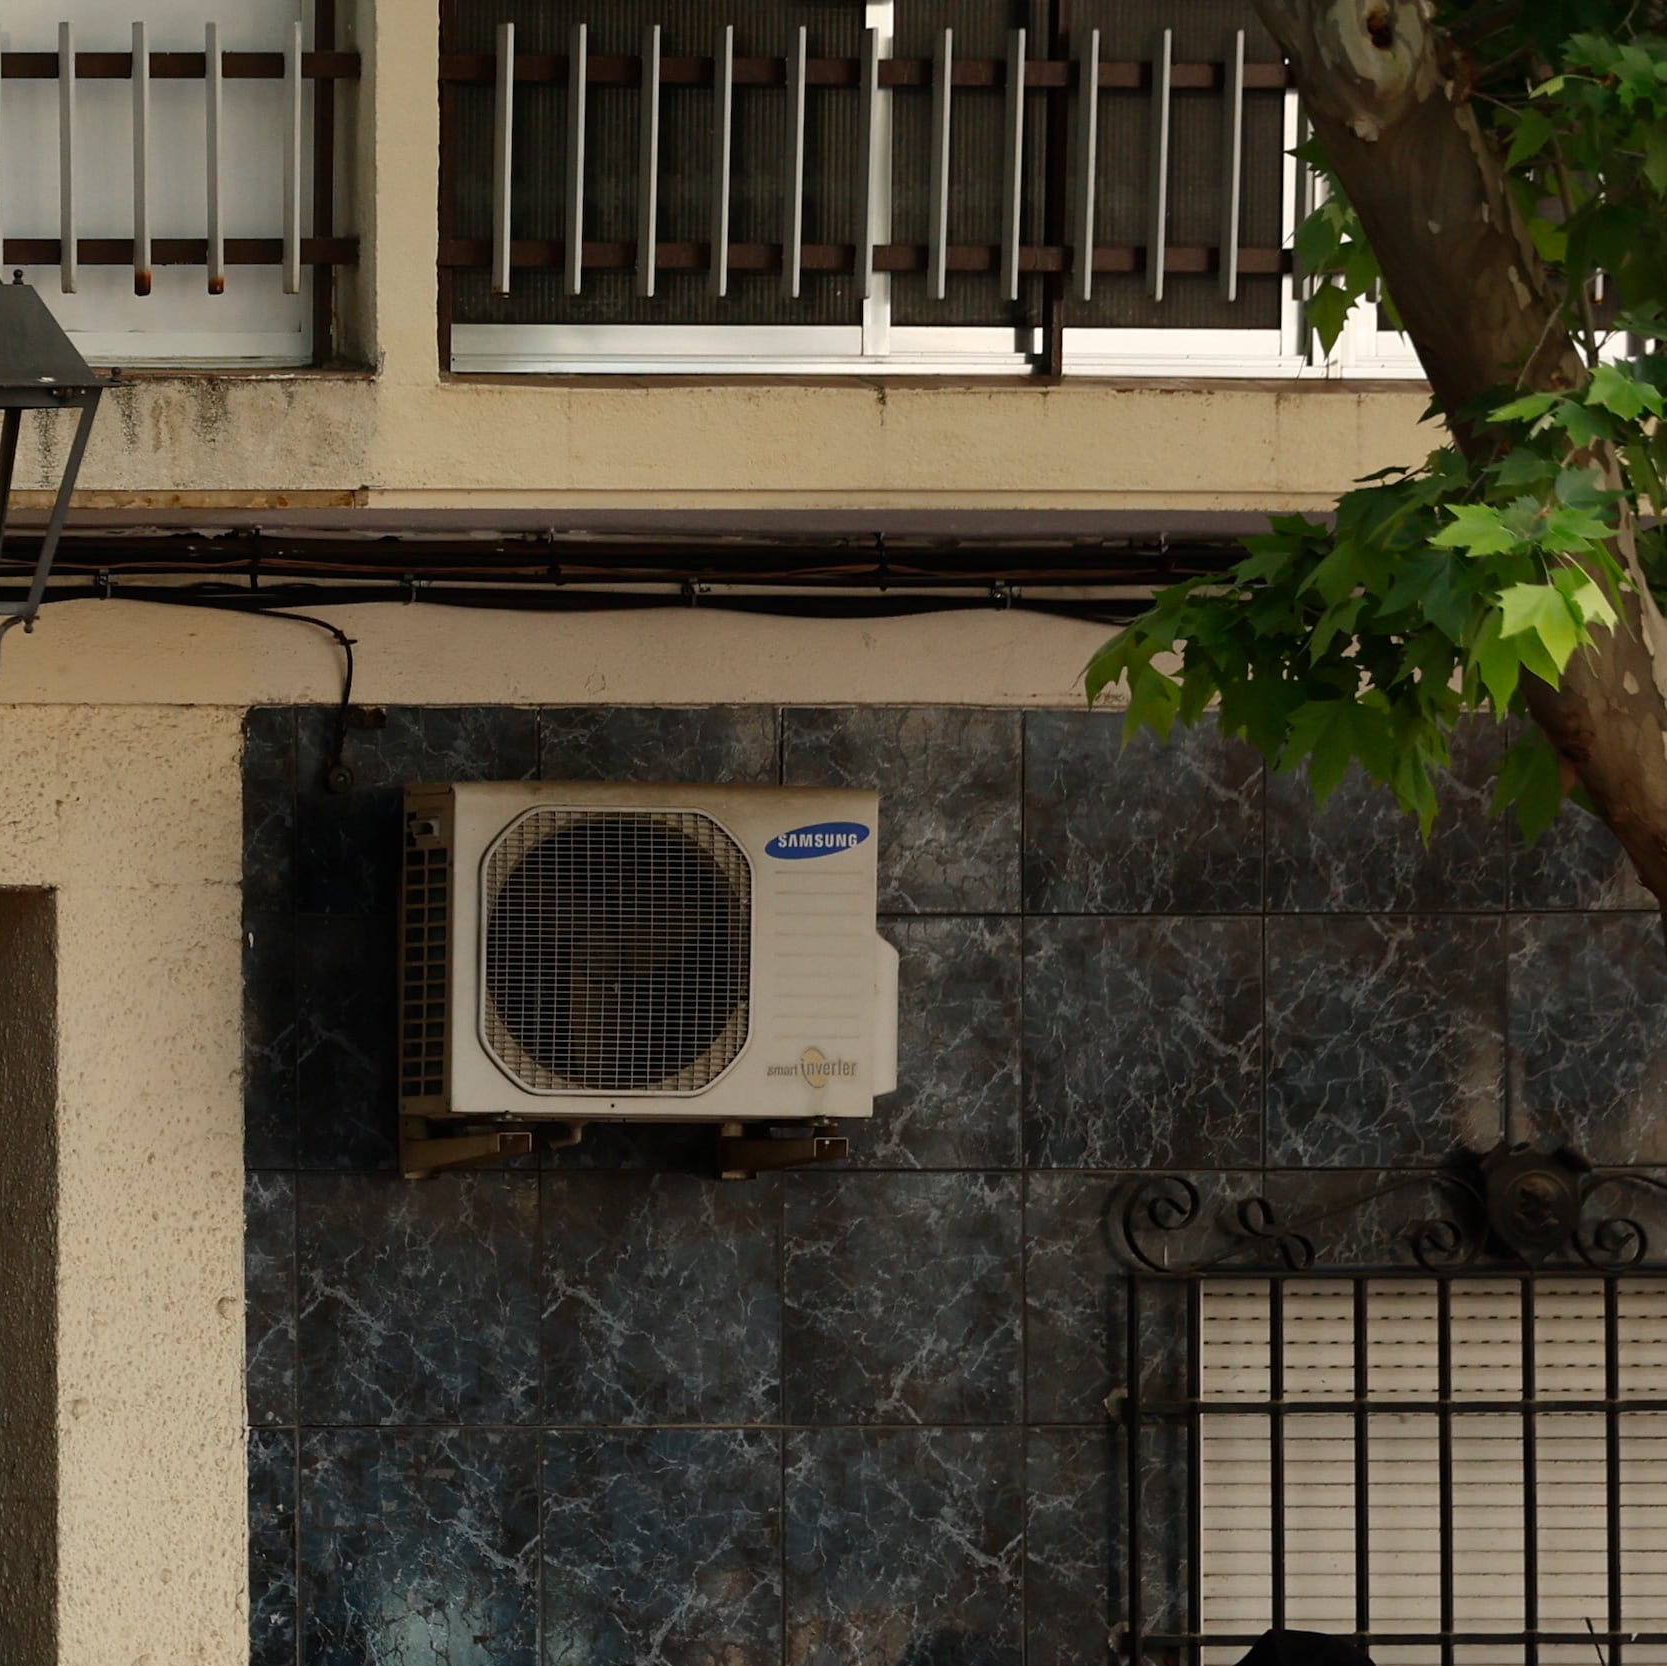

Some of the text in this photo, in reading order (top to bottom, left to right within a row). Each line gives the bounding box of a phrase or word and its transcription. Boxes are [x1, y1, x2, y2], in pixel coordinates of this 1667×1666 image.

[778, 833, 858, 848] SAMSUNG
[766, 1057, 857, 1077] smart inverter
